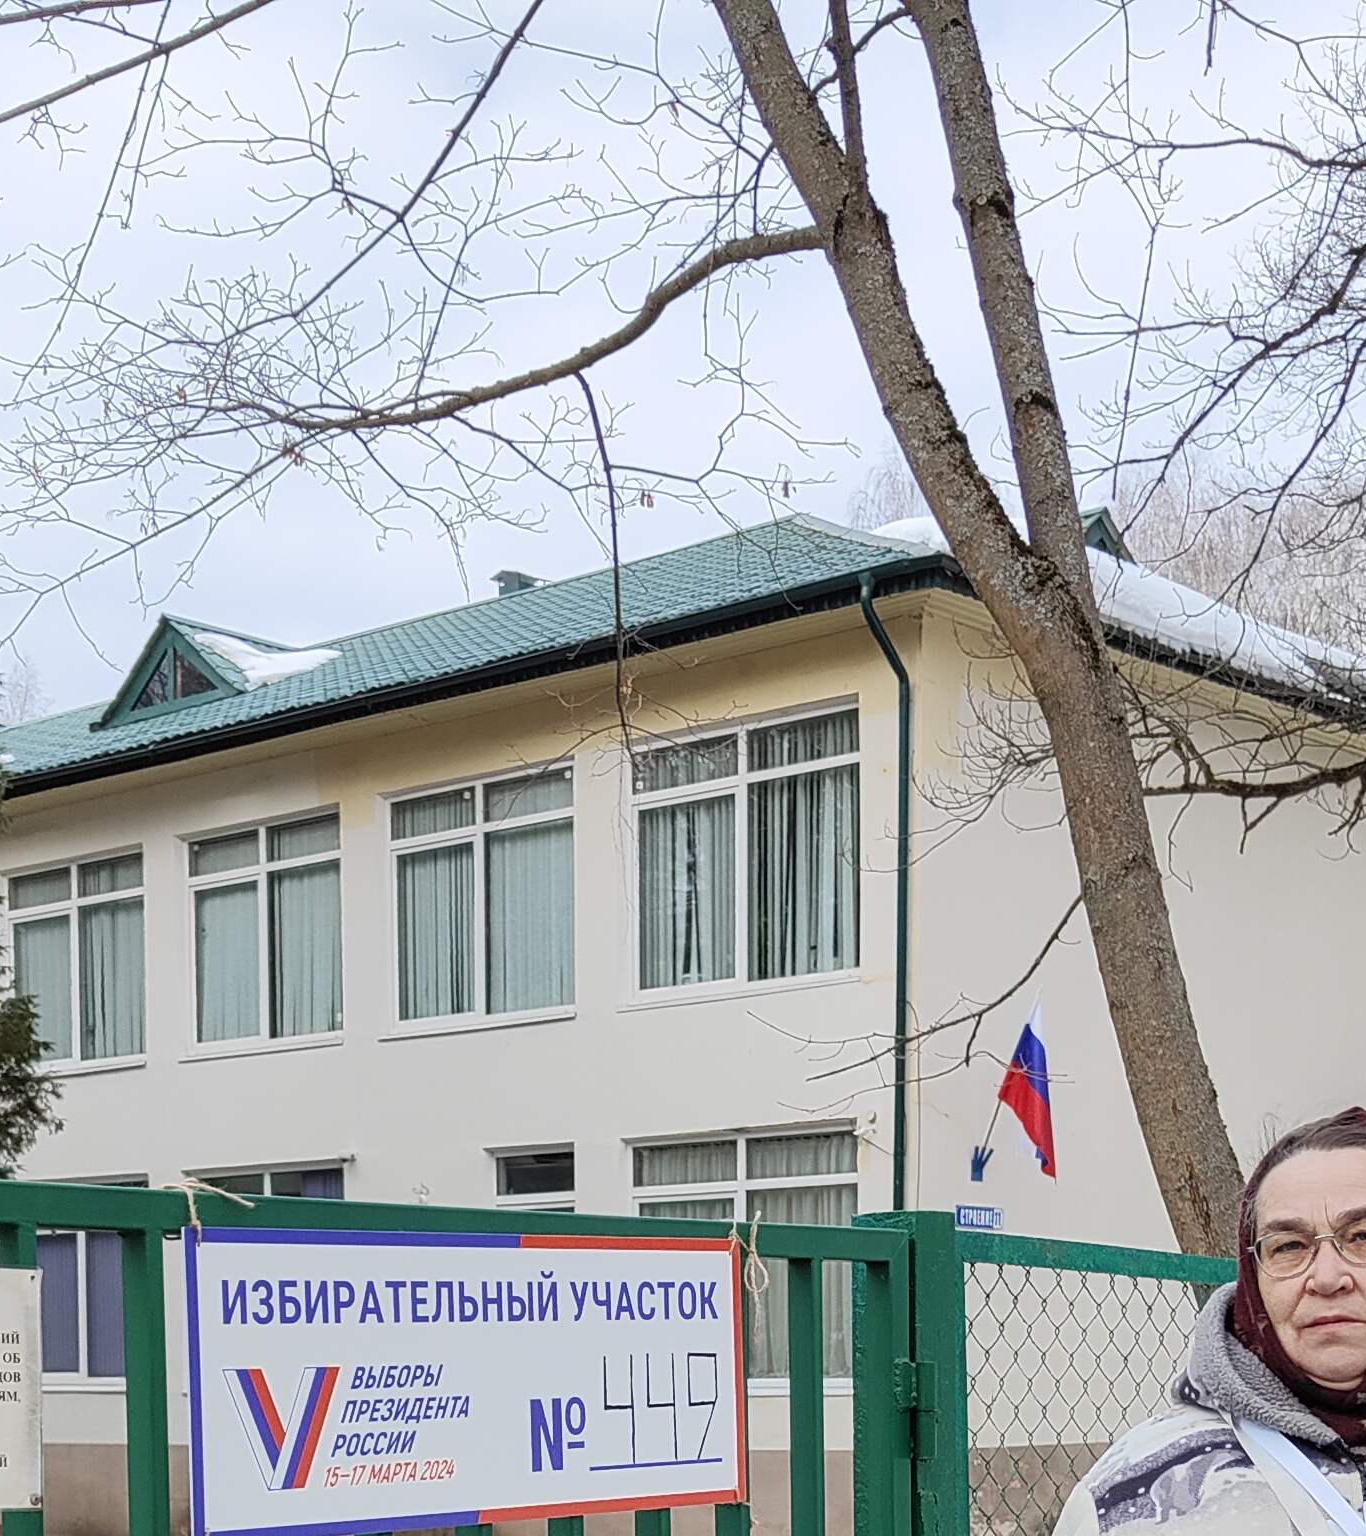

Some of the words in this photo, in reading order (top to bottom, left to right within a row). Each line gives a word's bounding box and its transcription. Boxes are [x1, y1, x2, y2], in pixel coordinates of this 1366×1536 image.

[220, 1271, 559, 1325] ИЗБИРАТЕЛЬНЫЙ
[569, 1281, 719, 1322] УЧАСТОК
[2, 1352, 21, 1364] ОБ
[350, 1363, 444, 1390] ВЫБОРЫ
[340, 1394, 471, 1426] ПРЕЗИДЕНТА
[603, 1352, 718, 1464] 449
[331, 1431, 416, 1458] РОССИИ
[530, 1396, 586, 1473] №
[368, 1463, 418, 1486] МАРТА
[419, 1459, 456, 1483] 2024
